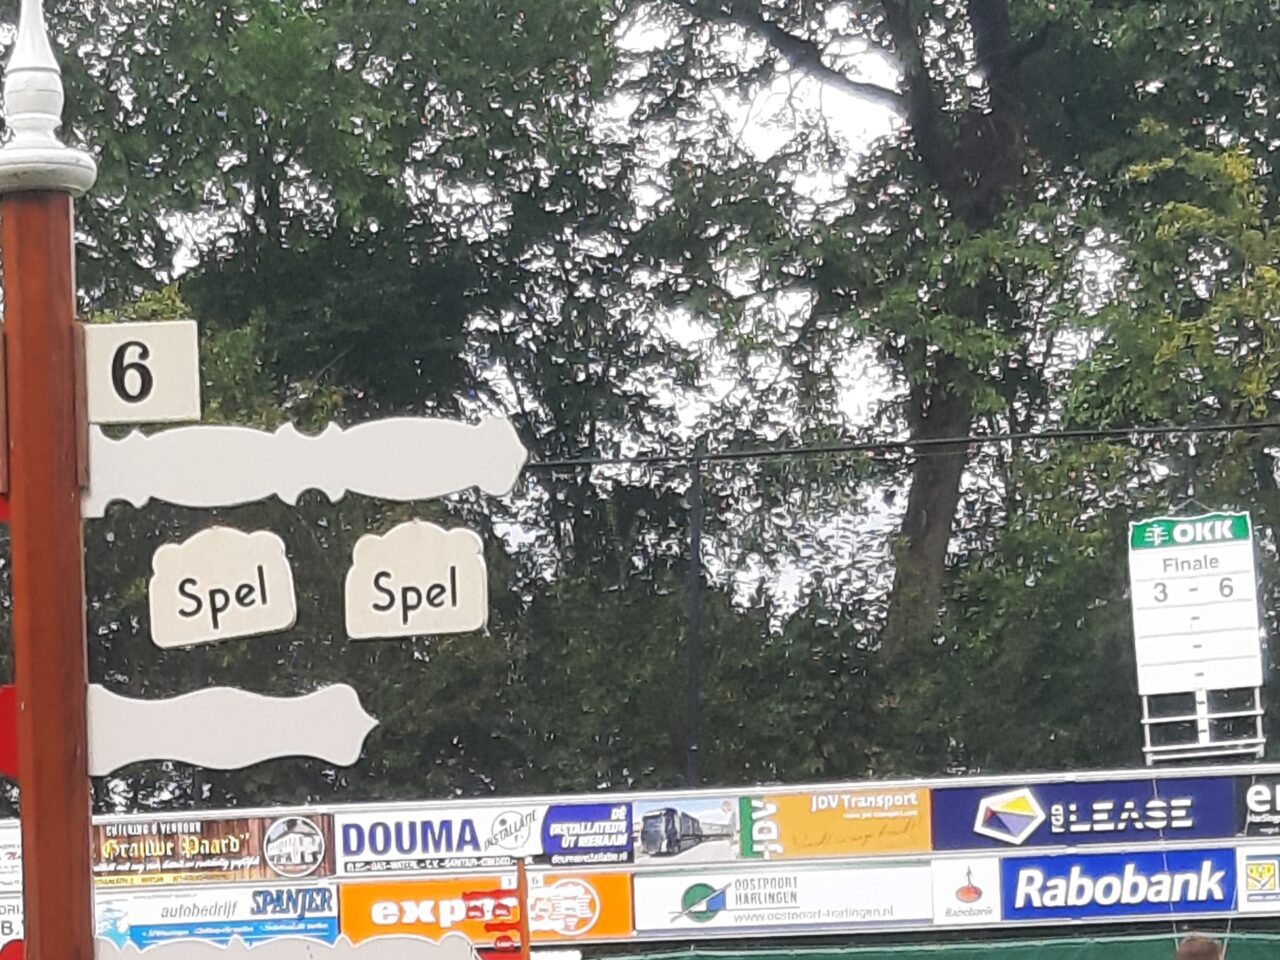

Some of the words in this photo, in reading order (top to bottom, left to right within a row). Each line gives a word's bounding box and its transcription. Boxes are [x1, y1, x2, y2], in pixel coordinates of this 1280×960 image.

[111, 341, 154, 404] 6
[1173, 520, 1233, 543] OKK
[1162, 554, 1219, 573] Finale
[177, 565, 269, 630] Spel
[372, 565, 458, 626] Spel
[1153, 582, 1168, 602] 3
[1219, 578, 1234, 598] 6
[811, 794, 839, 812] JDV
[841, 793, 918, 810] Transport
[1069, 798, 1194, 832] LEASE
[342, 818, 481, 857] DOUMA
[751, 800, 784, 854] JDV
[1014, 860, 1226, 909] Rabobank
